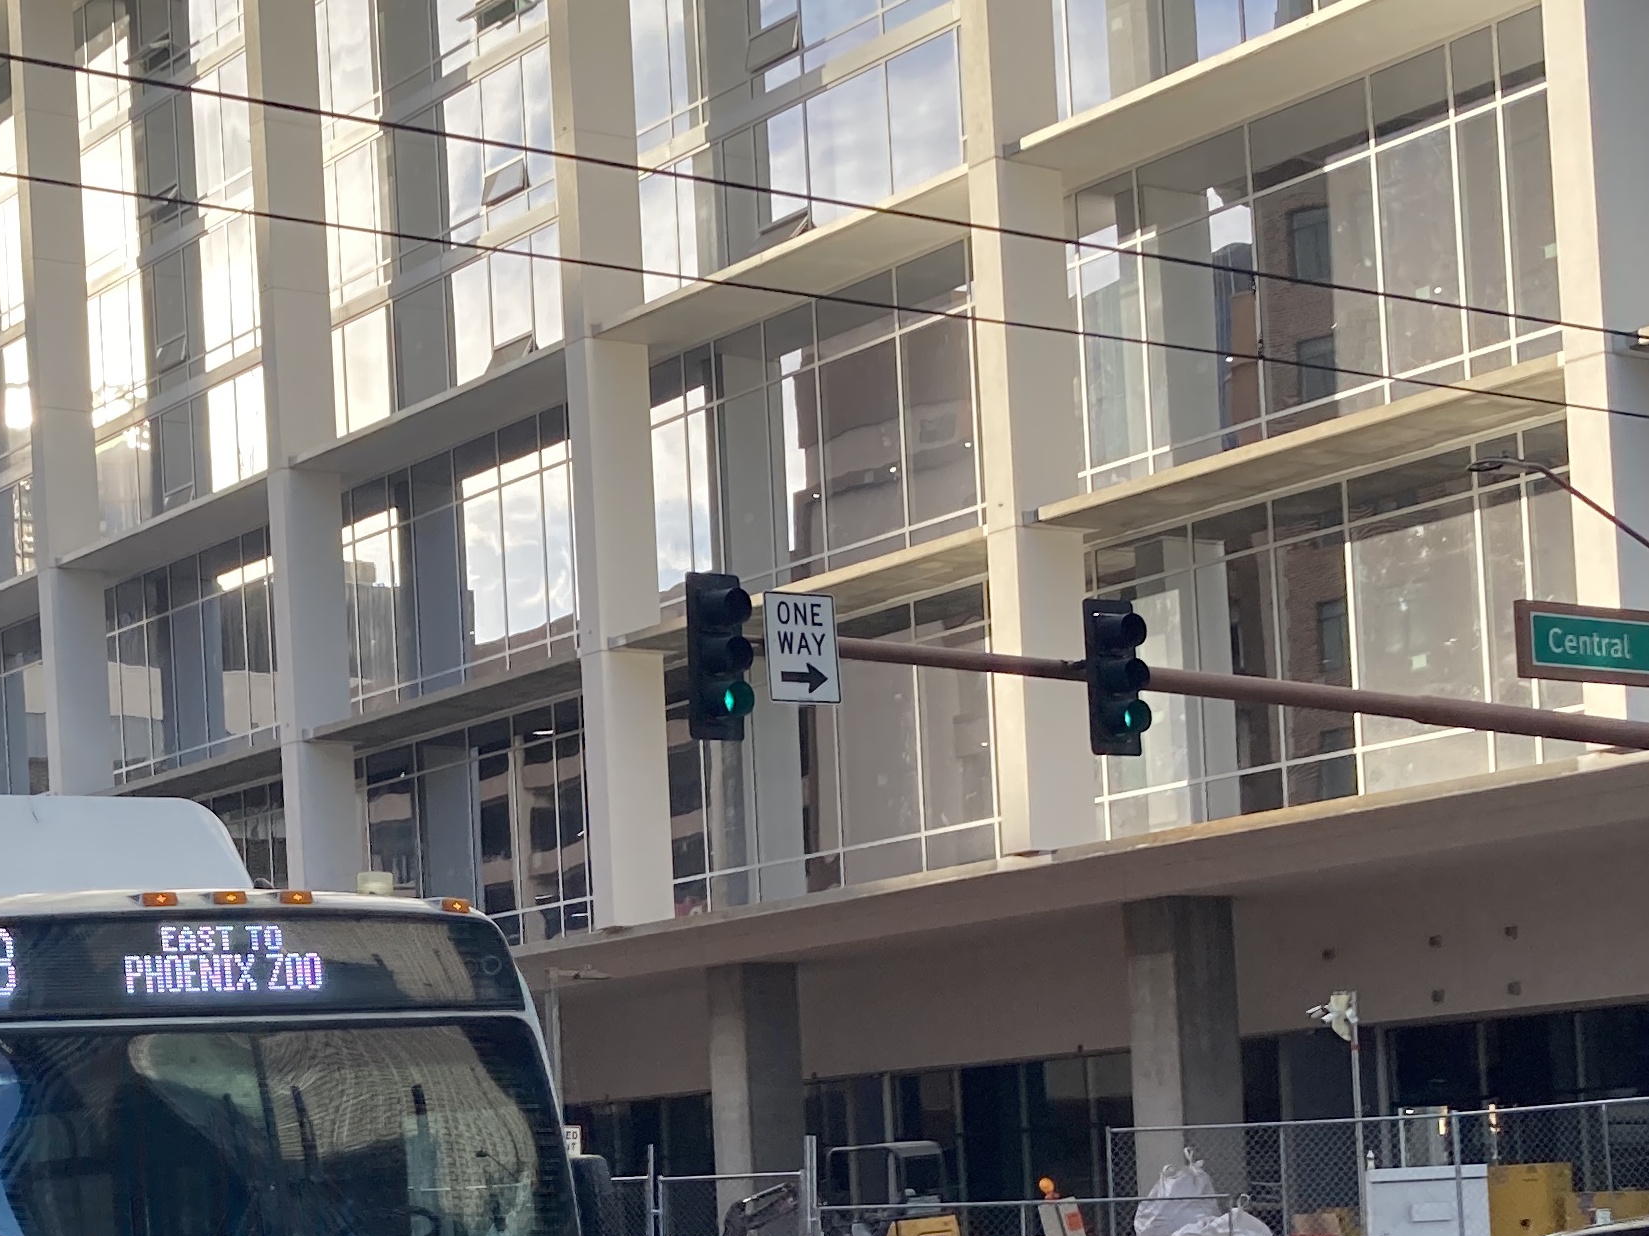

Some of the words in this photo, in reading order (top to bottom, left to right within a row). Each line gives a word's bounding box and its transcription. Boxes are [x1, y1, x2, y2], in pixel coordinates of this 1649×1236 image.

[777, 600, 823, 627] ONE
[777, 630, 826, 656] WAY
[1548, 627, 1631, 660] Central
[159, 925, 234, 952] EAST
[245, 925, 283, 951] TO
[123, 953, 258, 994] PHOENIX
[265, 952, 323, 991] ZOO
